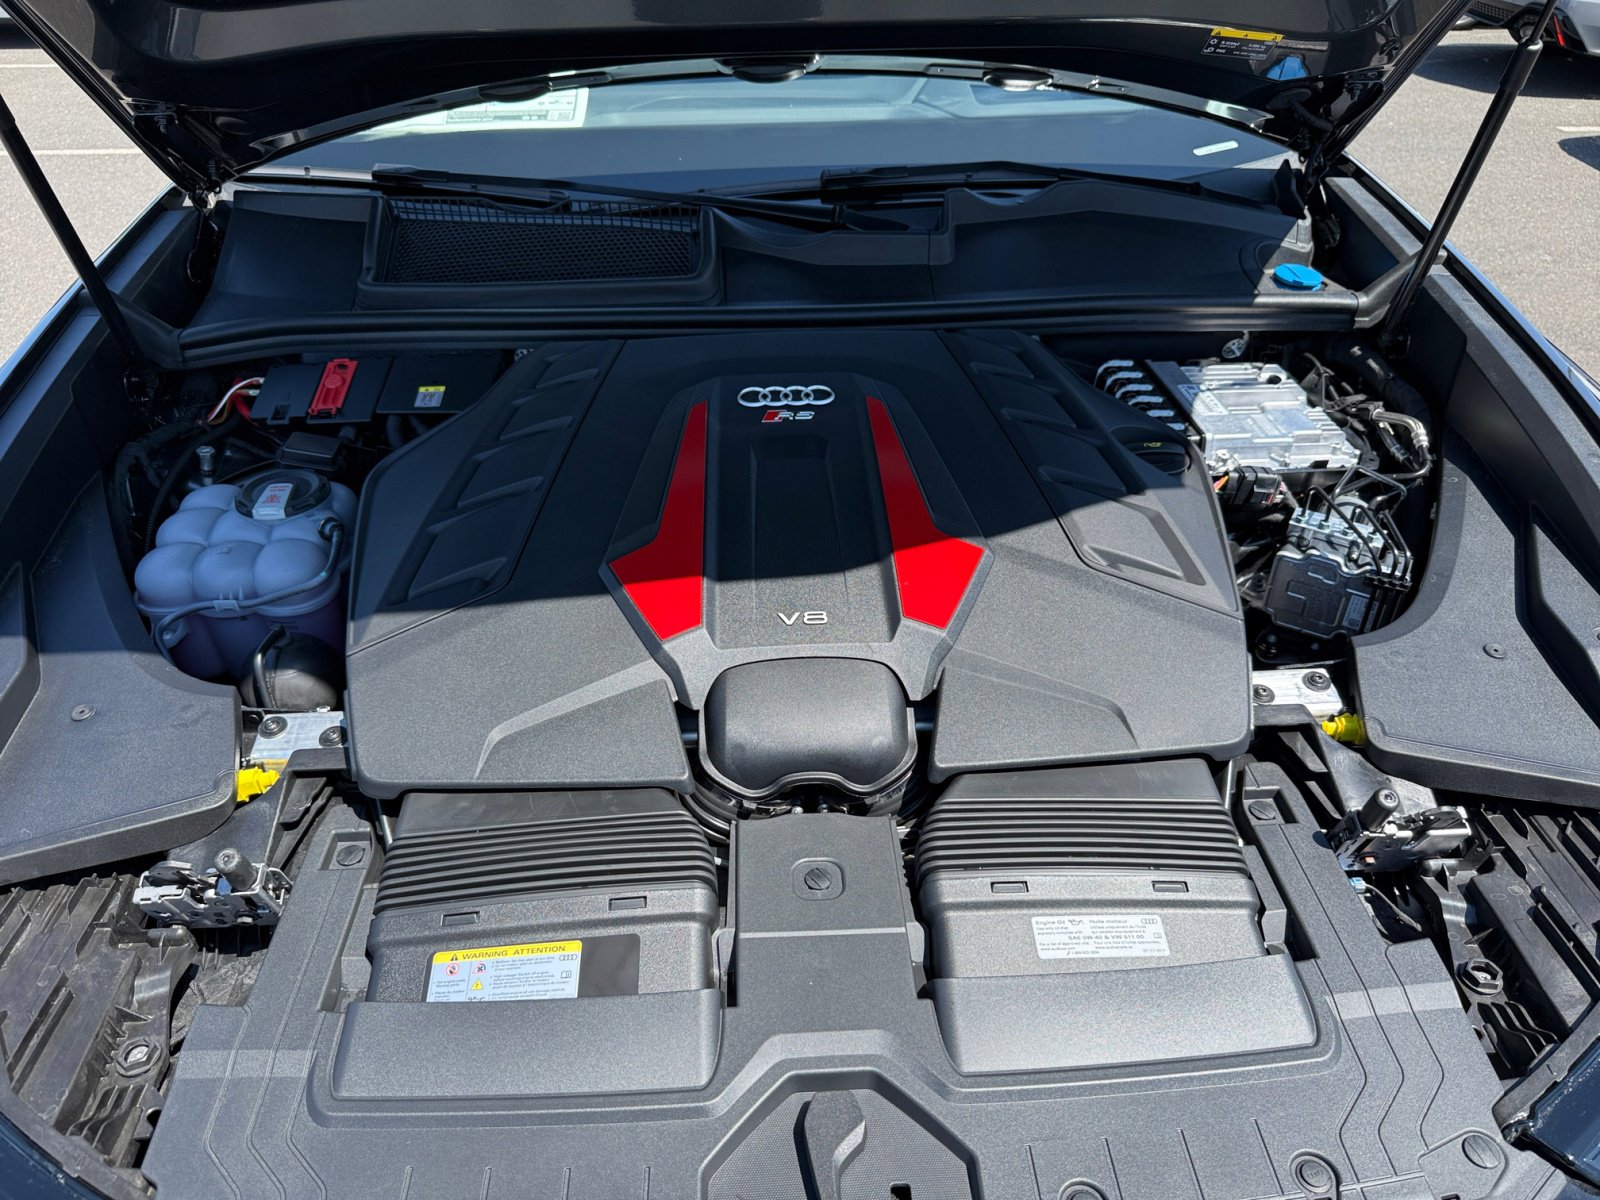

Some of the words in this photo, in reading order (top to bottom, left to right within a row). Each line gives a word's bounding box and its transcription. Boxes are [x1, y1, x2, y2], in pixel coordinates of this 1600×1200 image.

[766, 410, 815, 422] RS
[777, 611, 828, 626] V8
[462, 950, 508, 960] WARNING
[513, 946, 566, 956] ATTENTION
